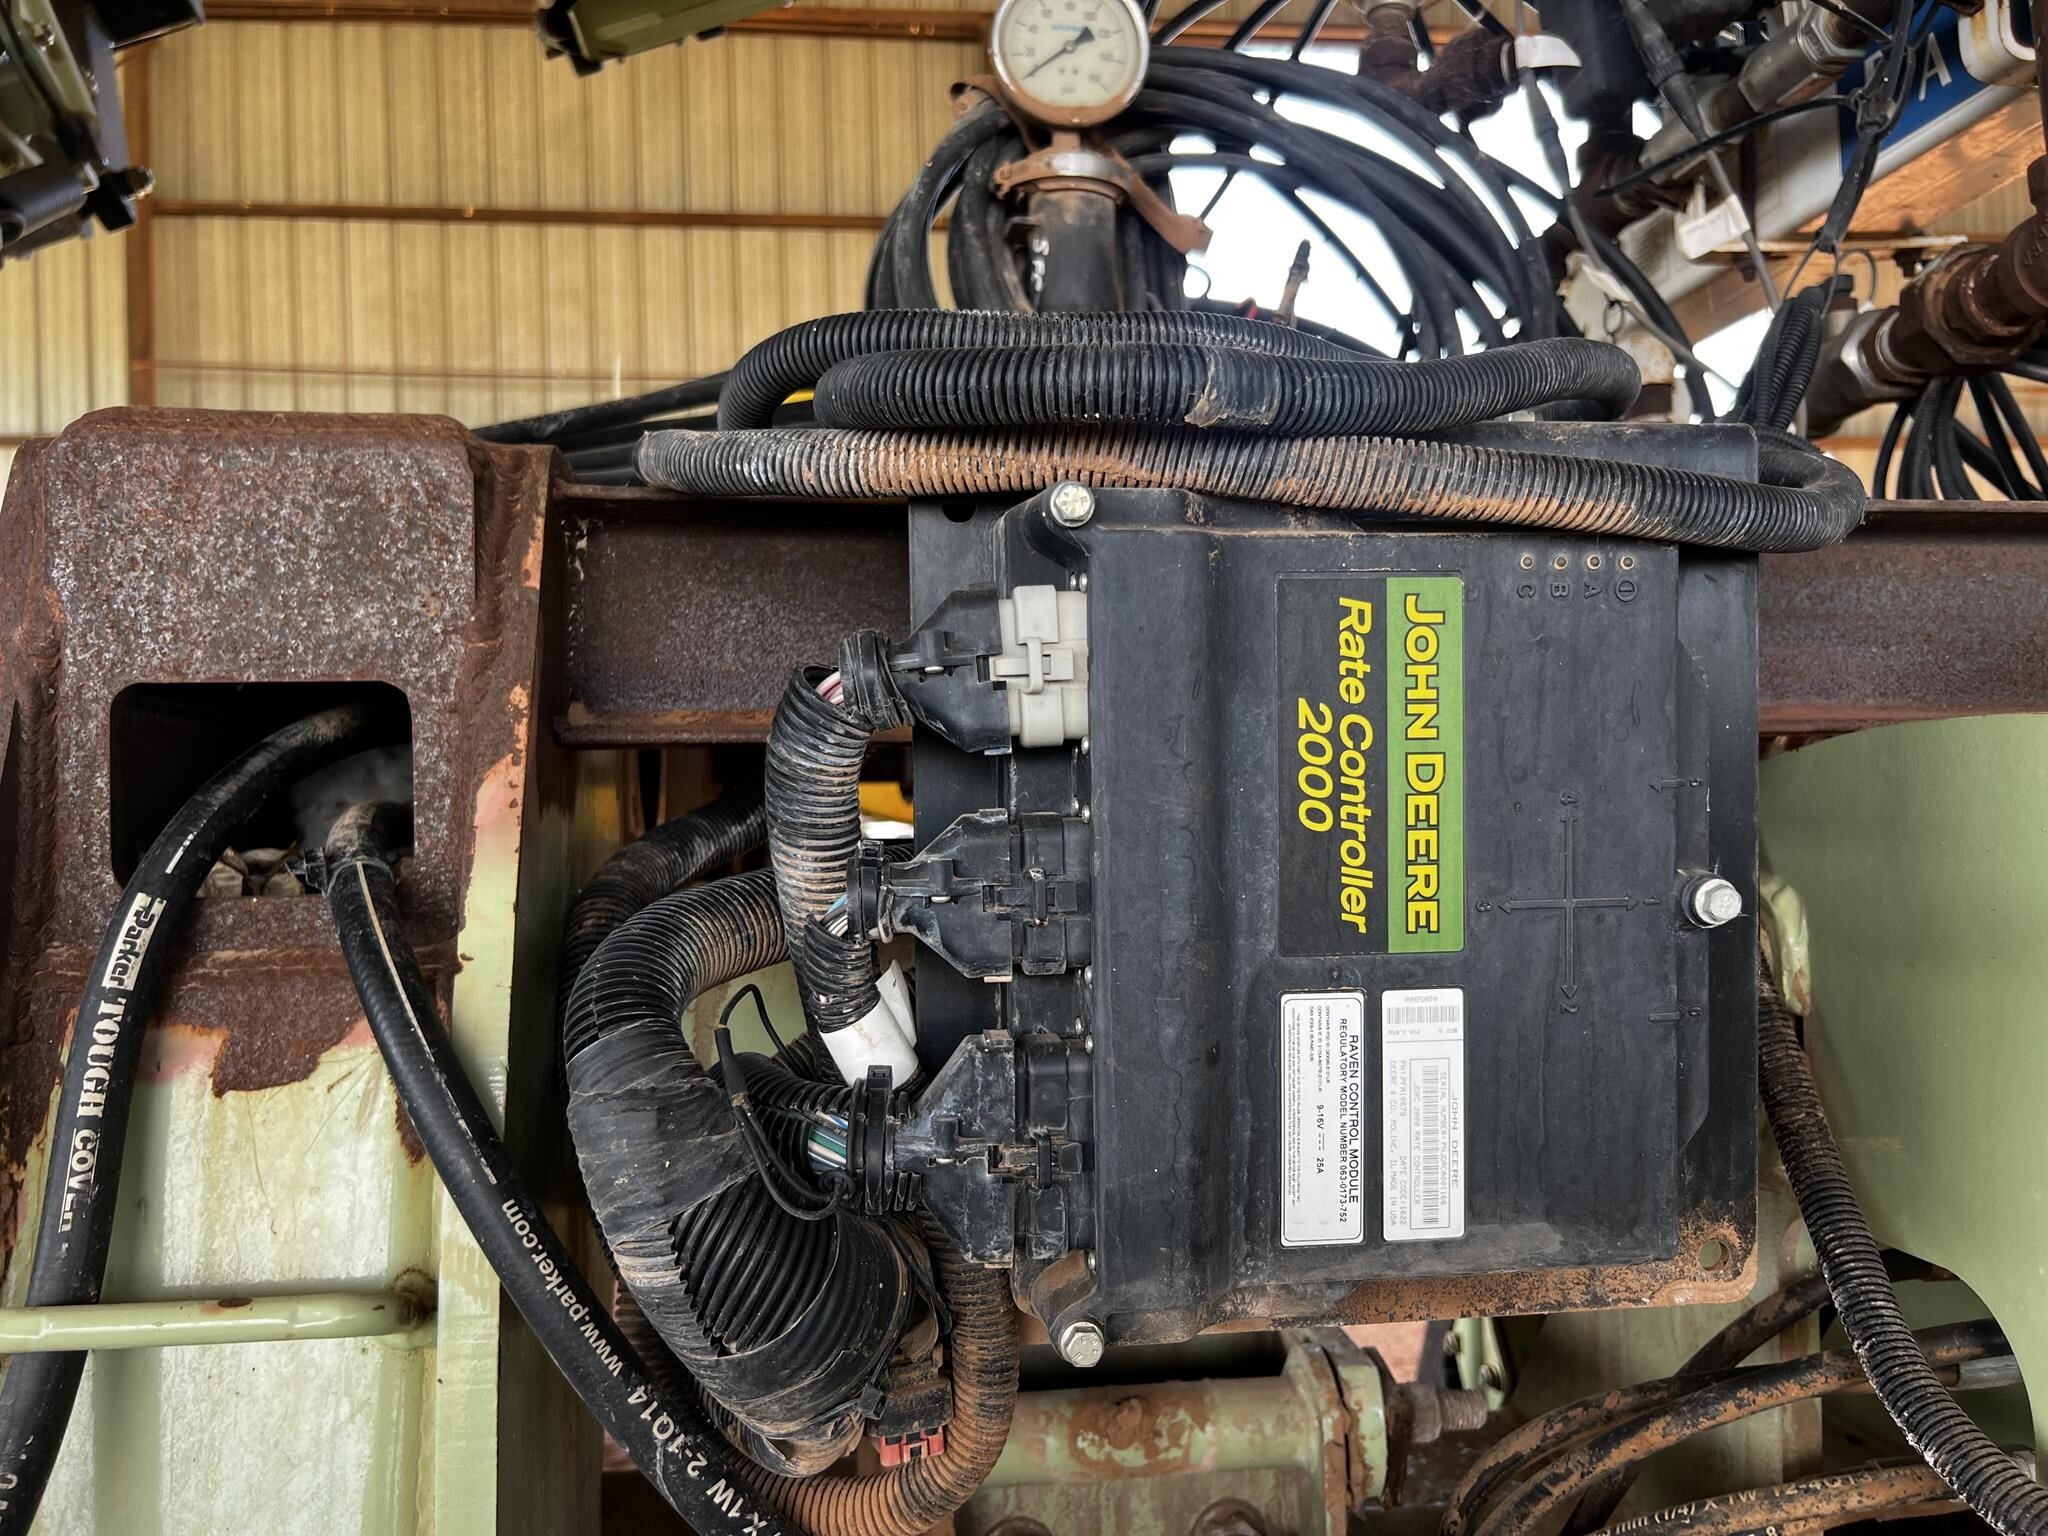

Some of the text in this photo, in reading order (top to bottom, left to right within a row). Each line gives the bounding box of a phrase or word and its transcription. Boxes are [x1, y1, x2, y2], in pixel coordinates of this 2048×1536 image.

[1298, 698, 1334, 832] 2000
[1339, 598, 1374, 933] Rate Controller
[1405, 593, 1446, 934] JOHN DEERE
[110, 897, 156, 987] Parker
[76, 997, 127, 1118] TOUGH
[1339, 1019, 1347, 1082] REGULATORY
[1349, 1035, 1359, 1203] RAVEN CONTROL MODULE
[1339, 1165, 1347, 1223] 063-0173-752
[501, 1198, 625, 1378] www.parker.com
[706, 1478, 744, 1518] 1W
